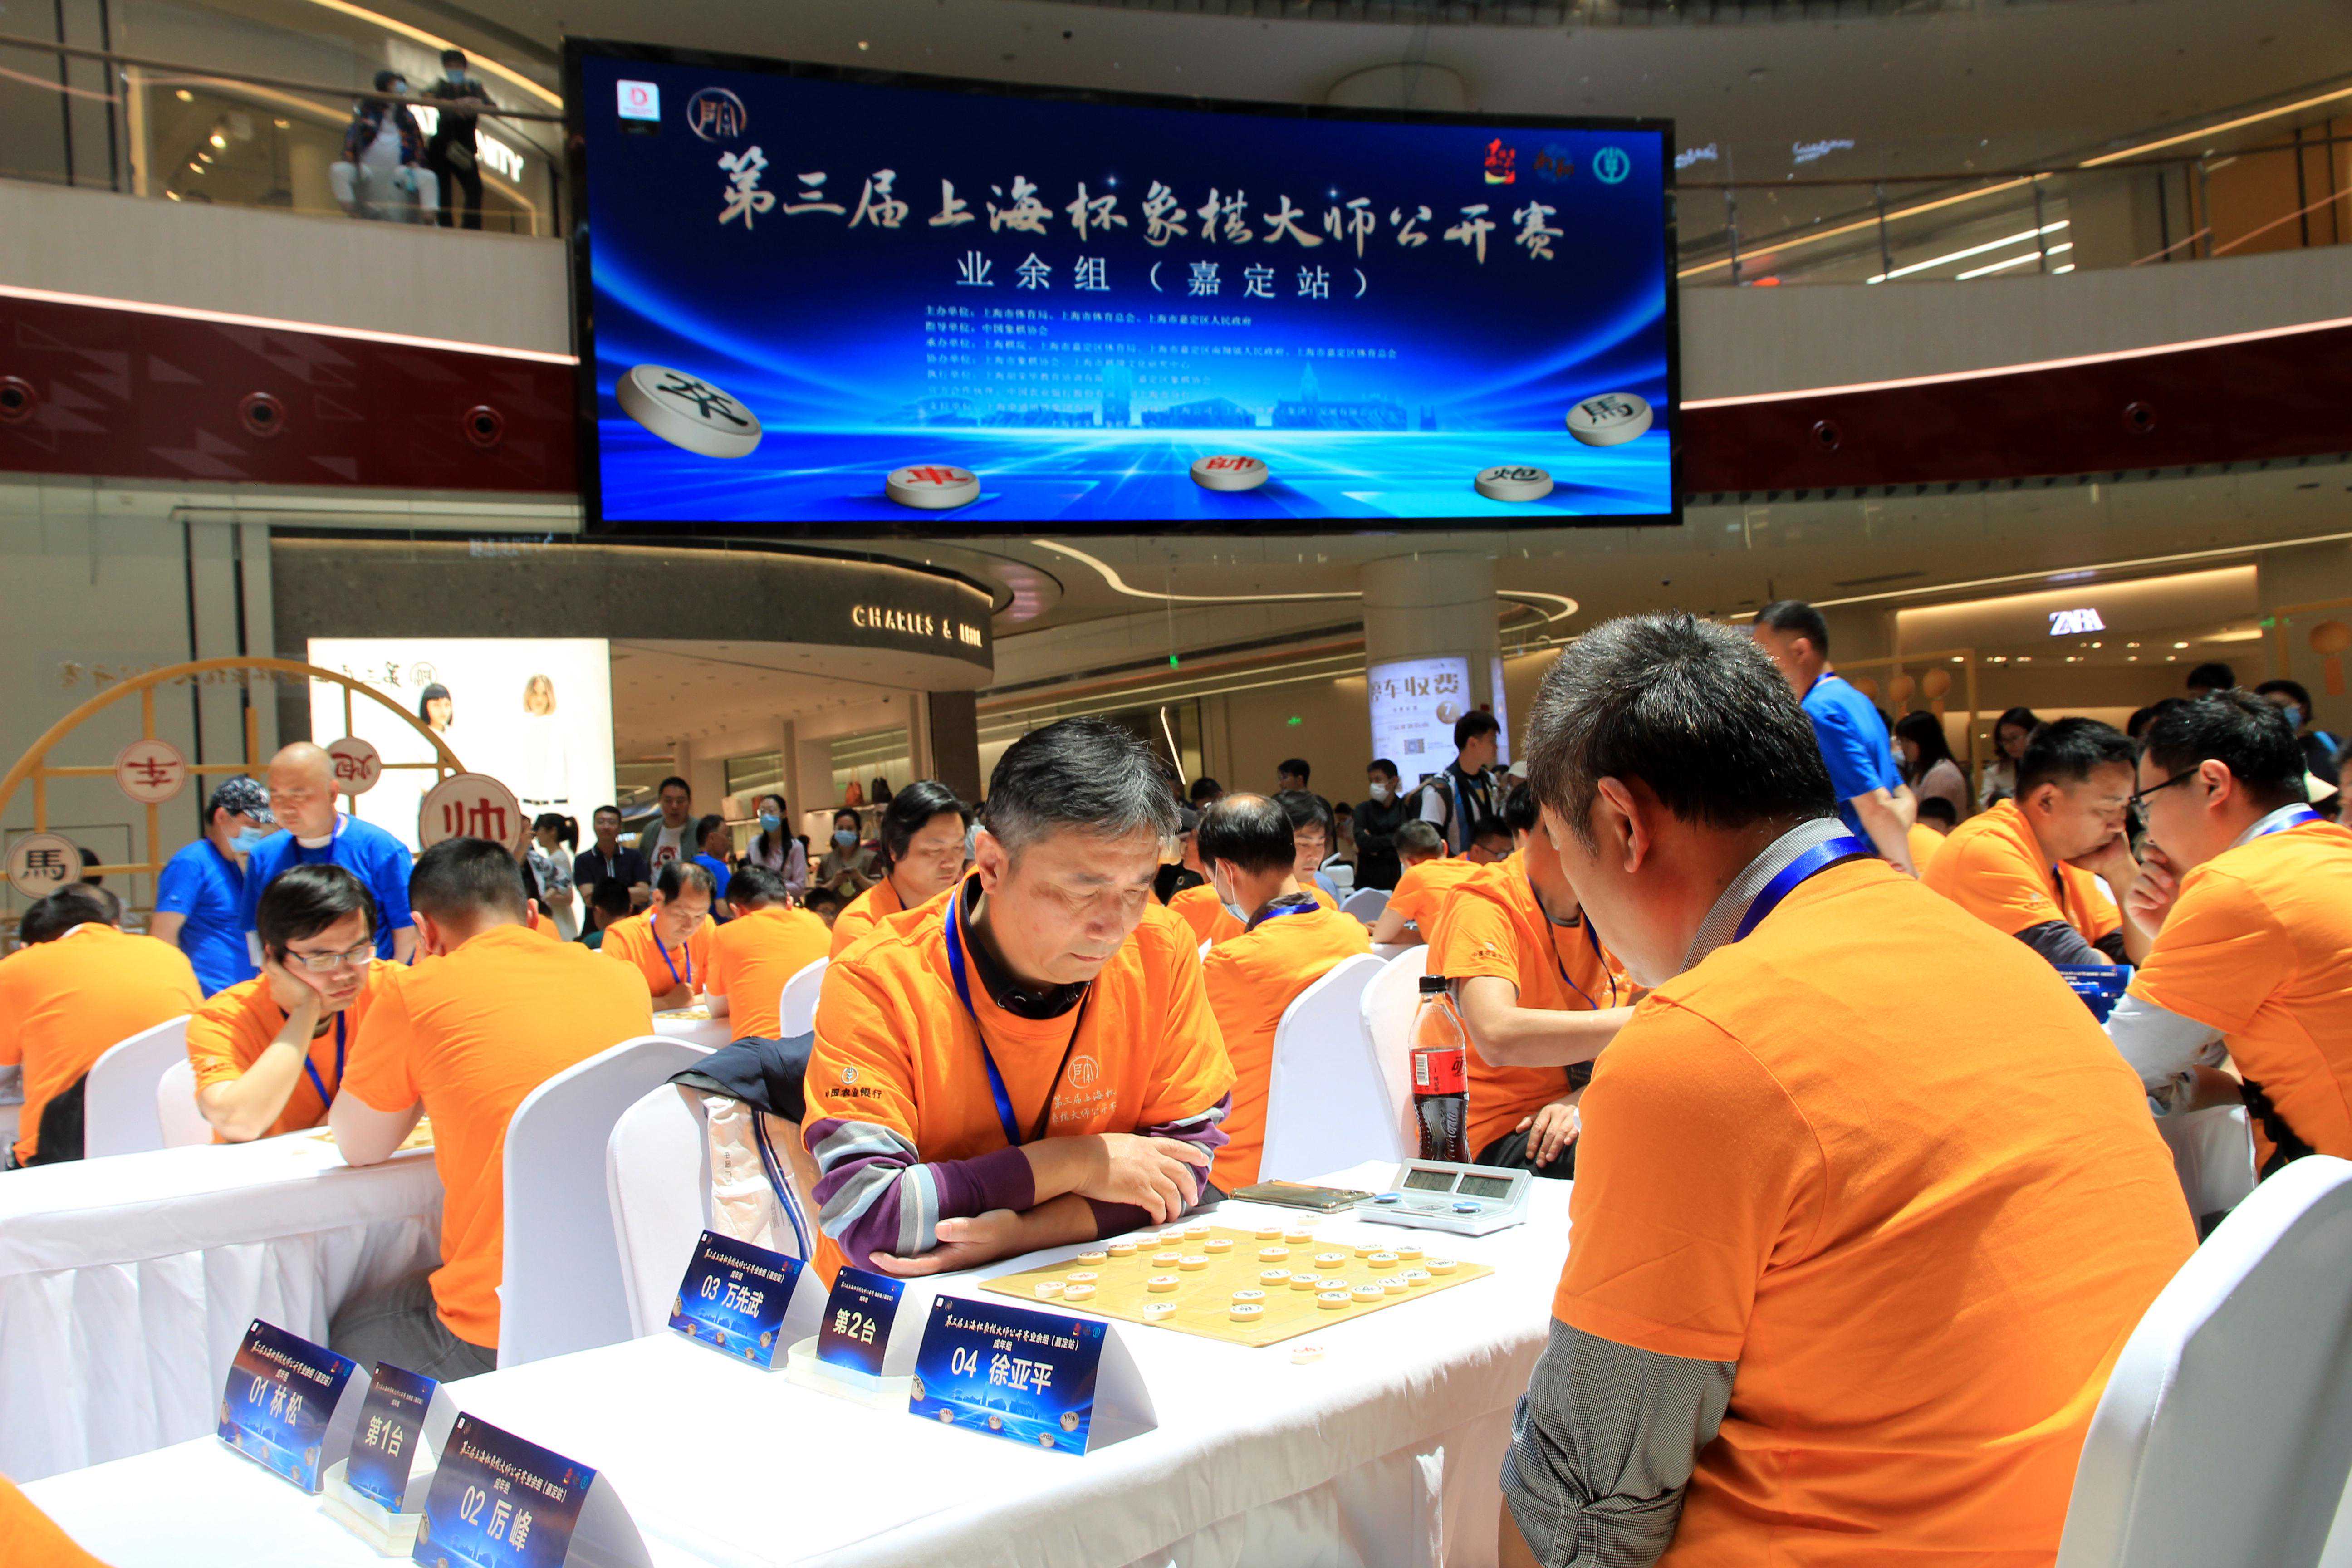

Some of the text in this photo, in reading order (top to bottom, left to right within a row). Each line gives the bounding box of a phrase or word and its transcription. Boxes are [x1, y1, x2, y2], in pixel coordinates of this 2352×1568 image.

[716, 145, 1565, 263] 第三届上海杯象棋大师公开赛
[852, 605, 934, 636] CHARLES
[2049, 608, 2106, 636] ZARA
[21, 850, 66, 880] 馬
[701, 1274, 764, 1319] 03 万先武
[832, 1308, 877, 1346] 第2台
[992, 1338, 1013, 1352] 成年组
[951, 1346, 1054, 1396] 04 徐亚平
[249, 1375, 303, 1426] 01 林松
[364, 1415, 404, 1458] 第1台
[460, 1485, 533, 1553] 02 厉峰
